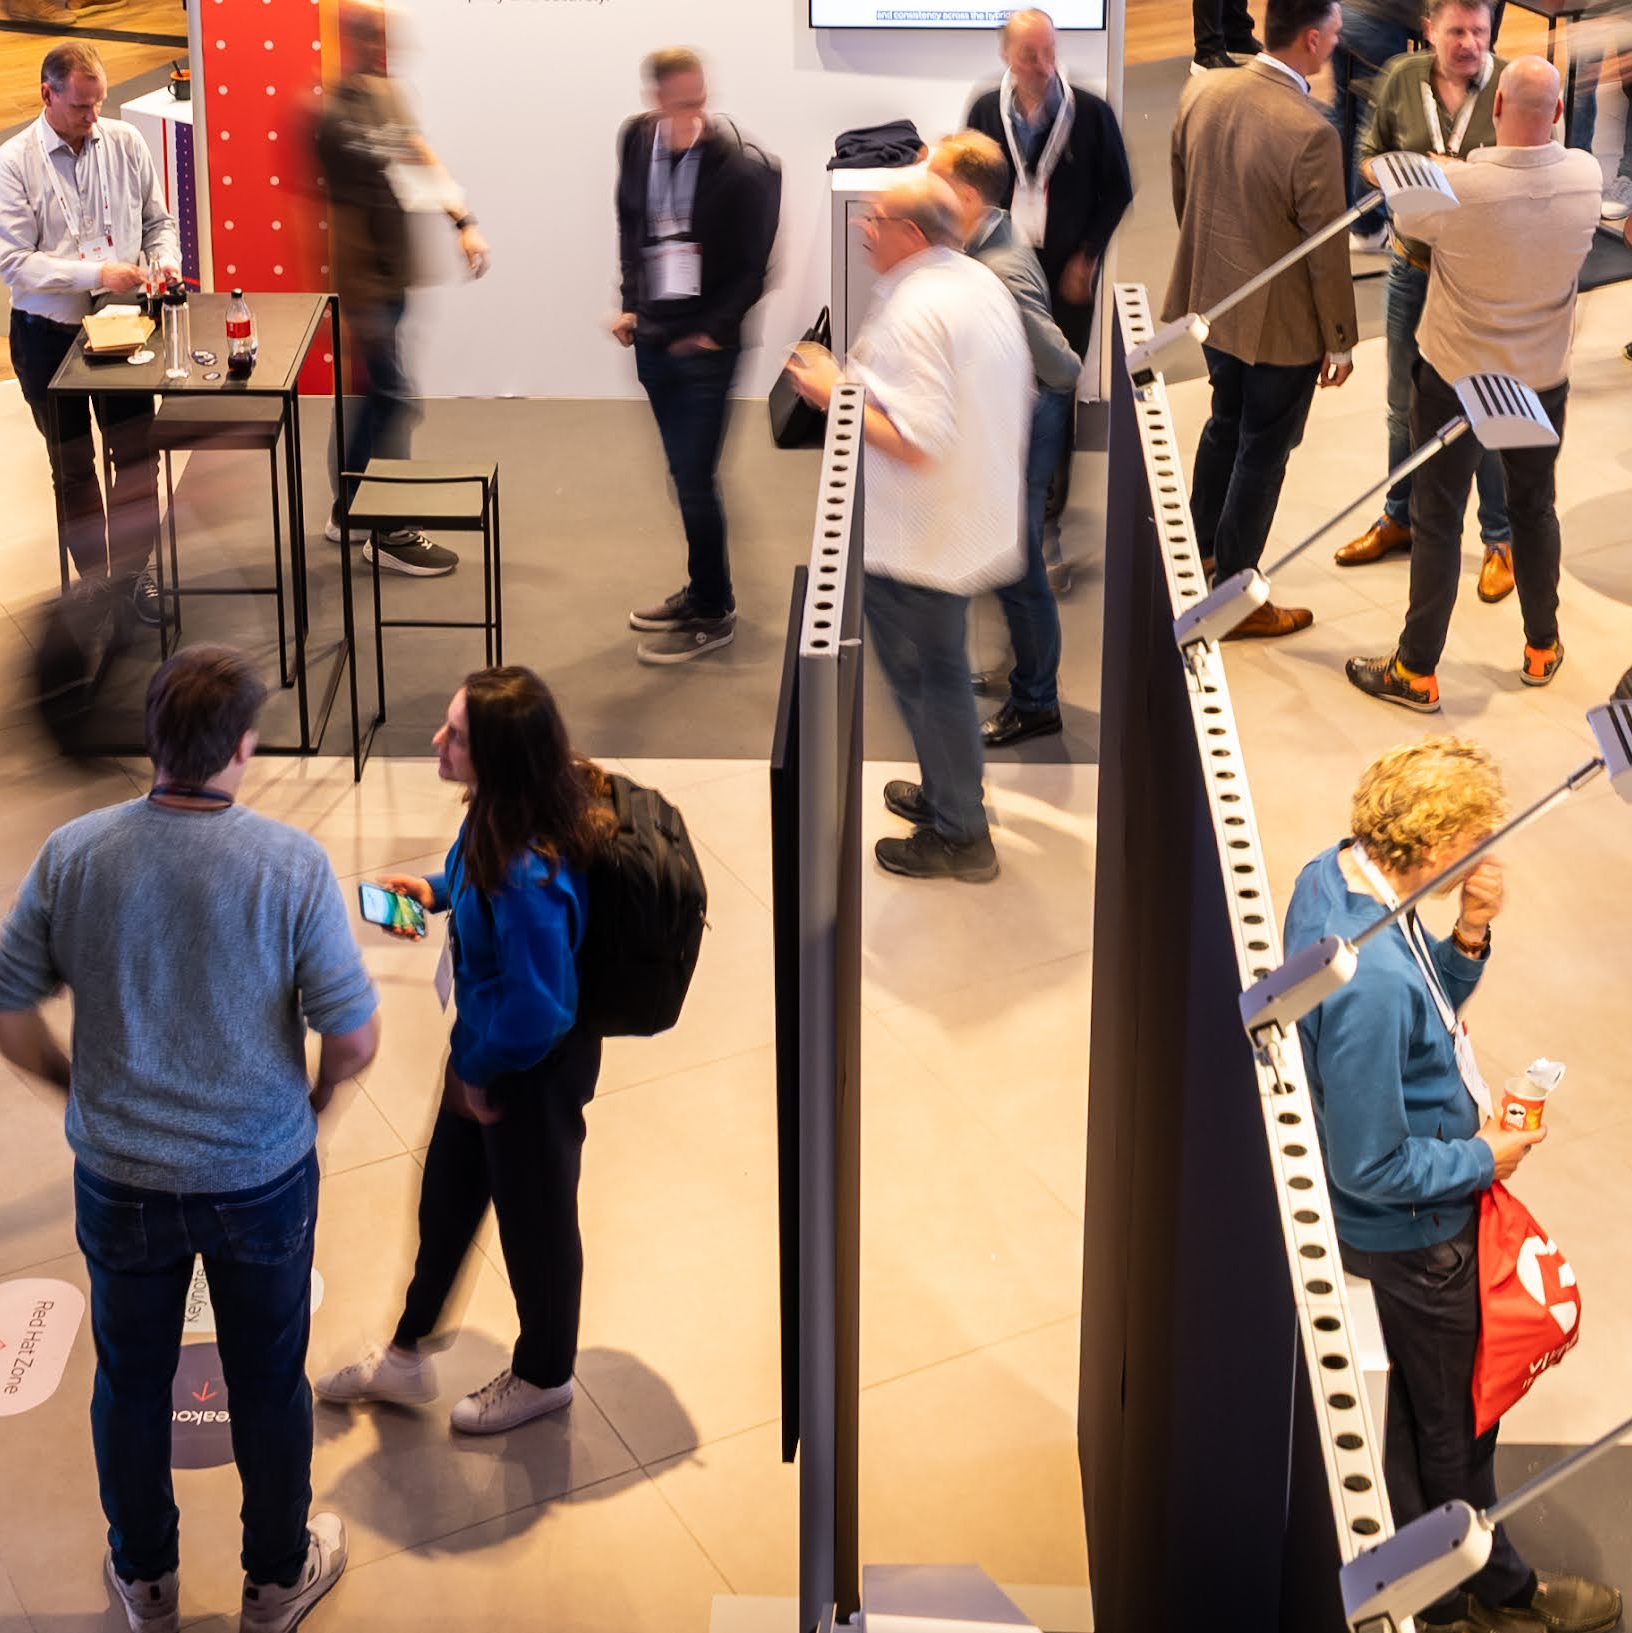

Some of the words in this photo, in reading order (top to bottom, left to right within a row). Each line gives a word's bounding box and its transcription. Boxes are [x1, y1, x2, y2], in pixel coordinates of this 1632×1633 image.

[28, 1300, 55, 1328] Red
[19, 1328, 45, 1359] Hat
[3, 1357, 34, 1396] Zone
[172, 1410, 231, 1425] eako
